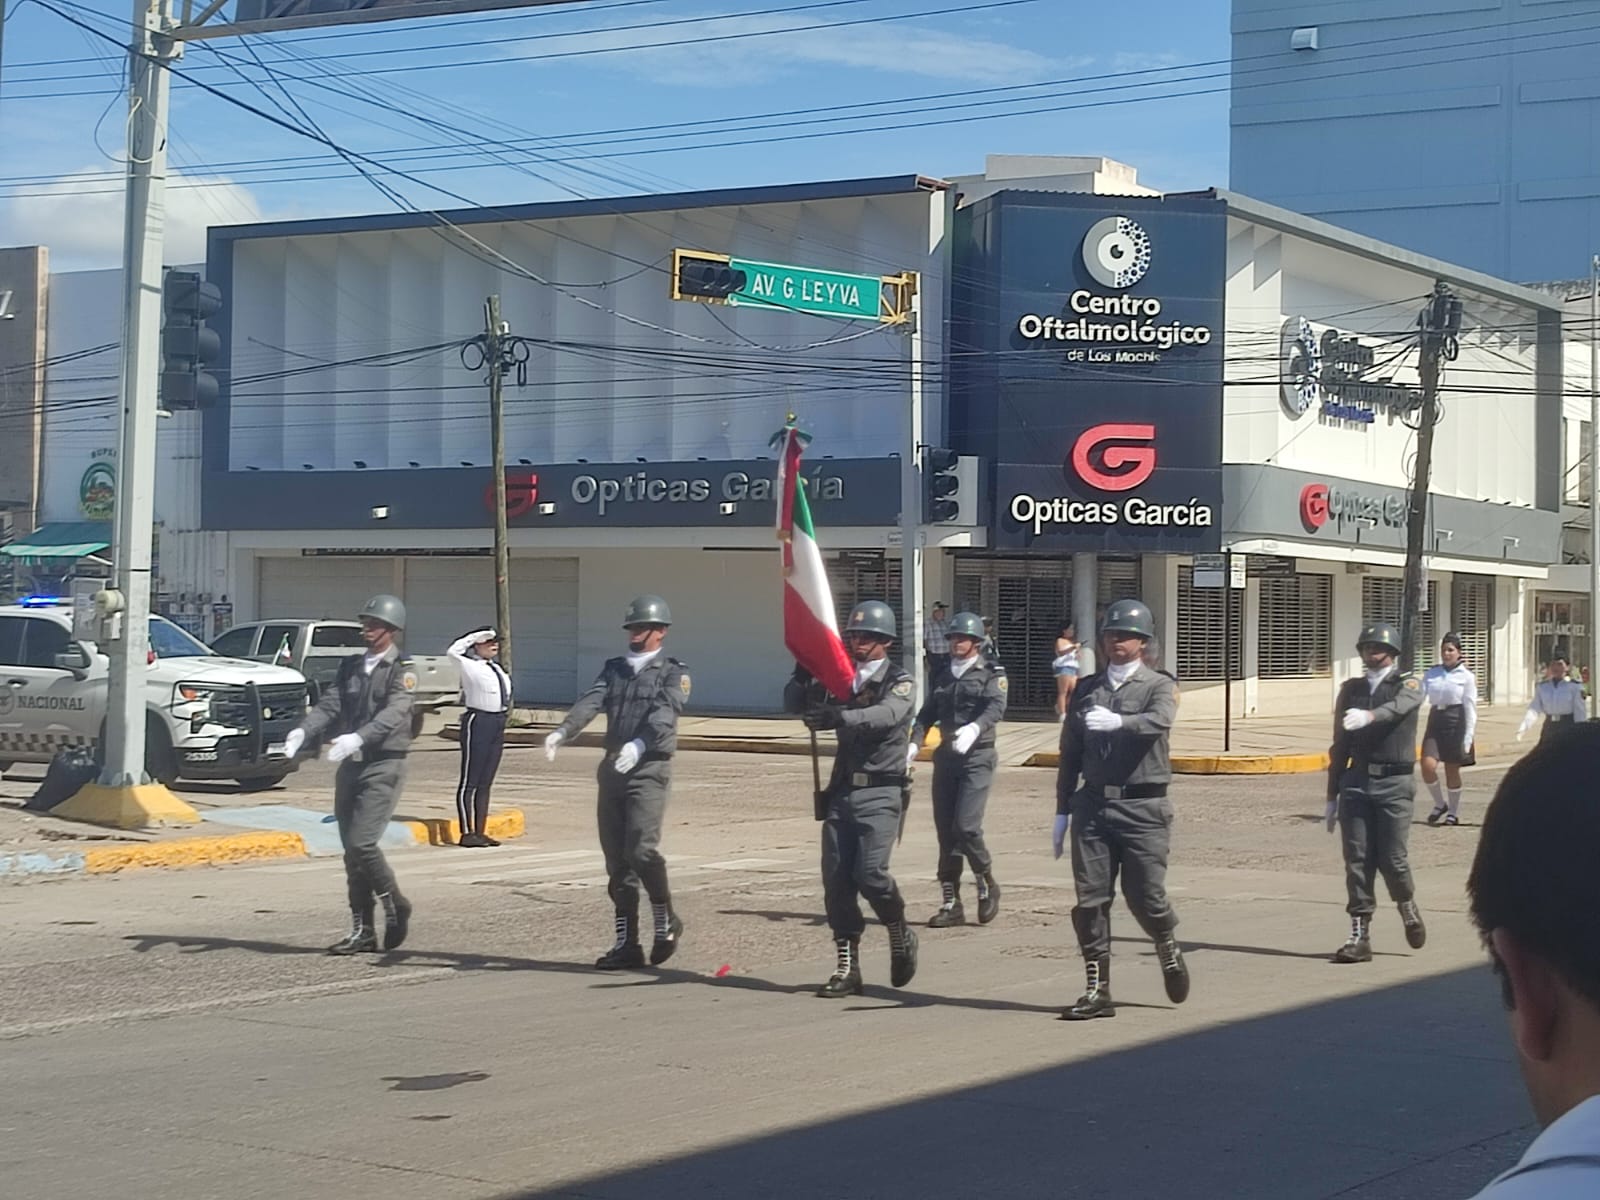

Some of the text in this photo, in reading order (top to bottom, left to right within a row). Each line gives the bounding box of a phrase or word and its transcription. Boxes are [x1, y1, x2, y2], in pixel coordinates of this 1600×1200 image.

[752, 274, 860, 307] AV. G. LEYVA
[1070, 290, 1161, 316] Centro
[1019, 314, 1211, 349] Oftalmológico
[1067, 349, 1084, 362] de
[1088, 348, 1112, 362] Los
[571, 471, 711, 515] Opticas
[1011, 494, 1212, 535] Opticas García
[17, 696, 85, 711] NACIONAL
